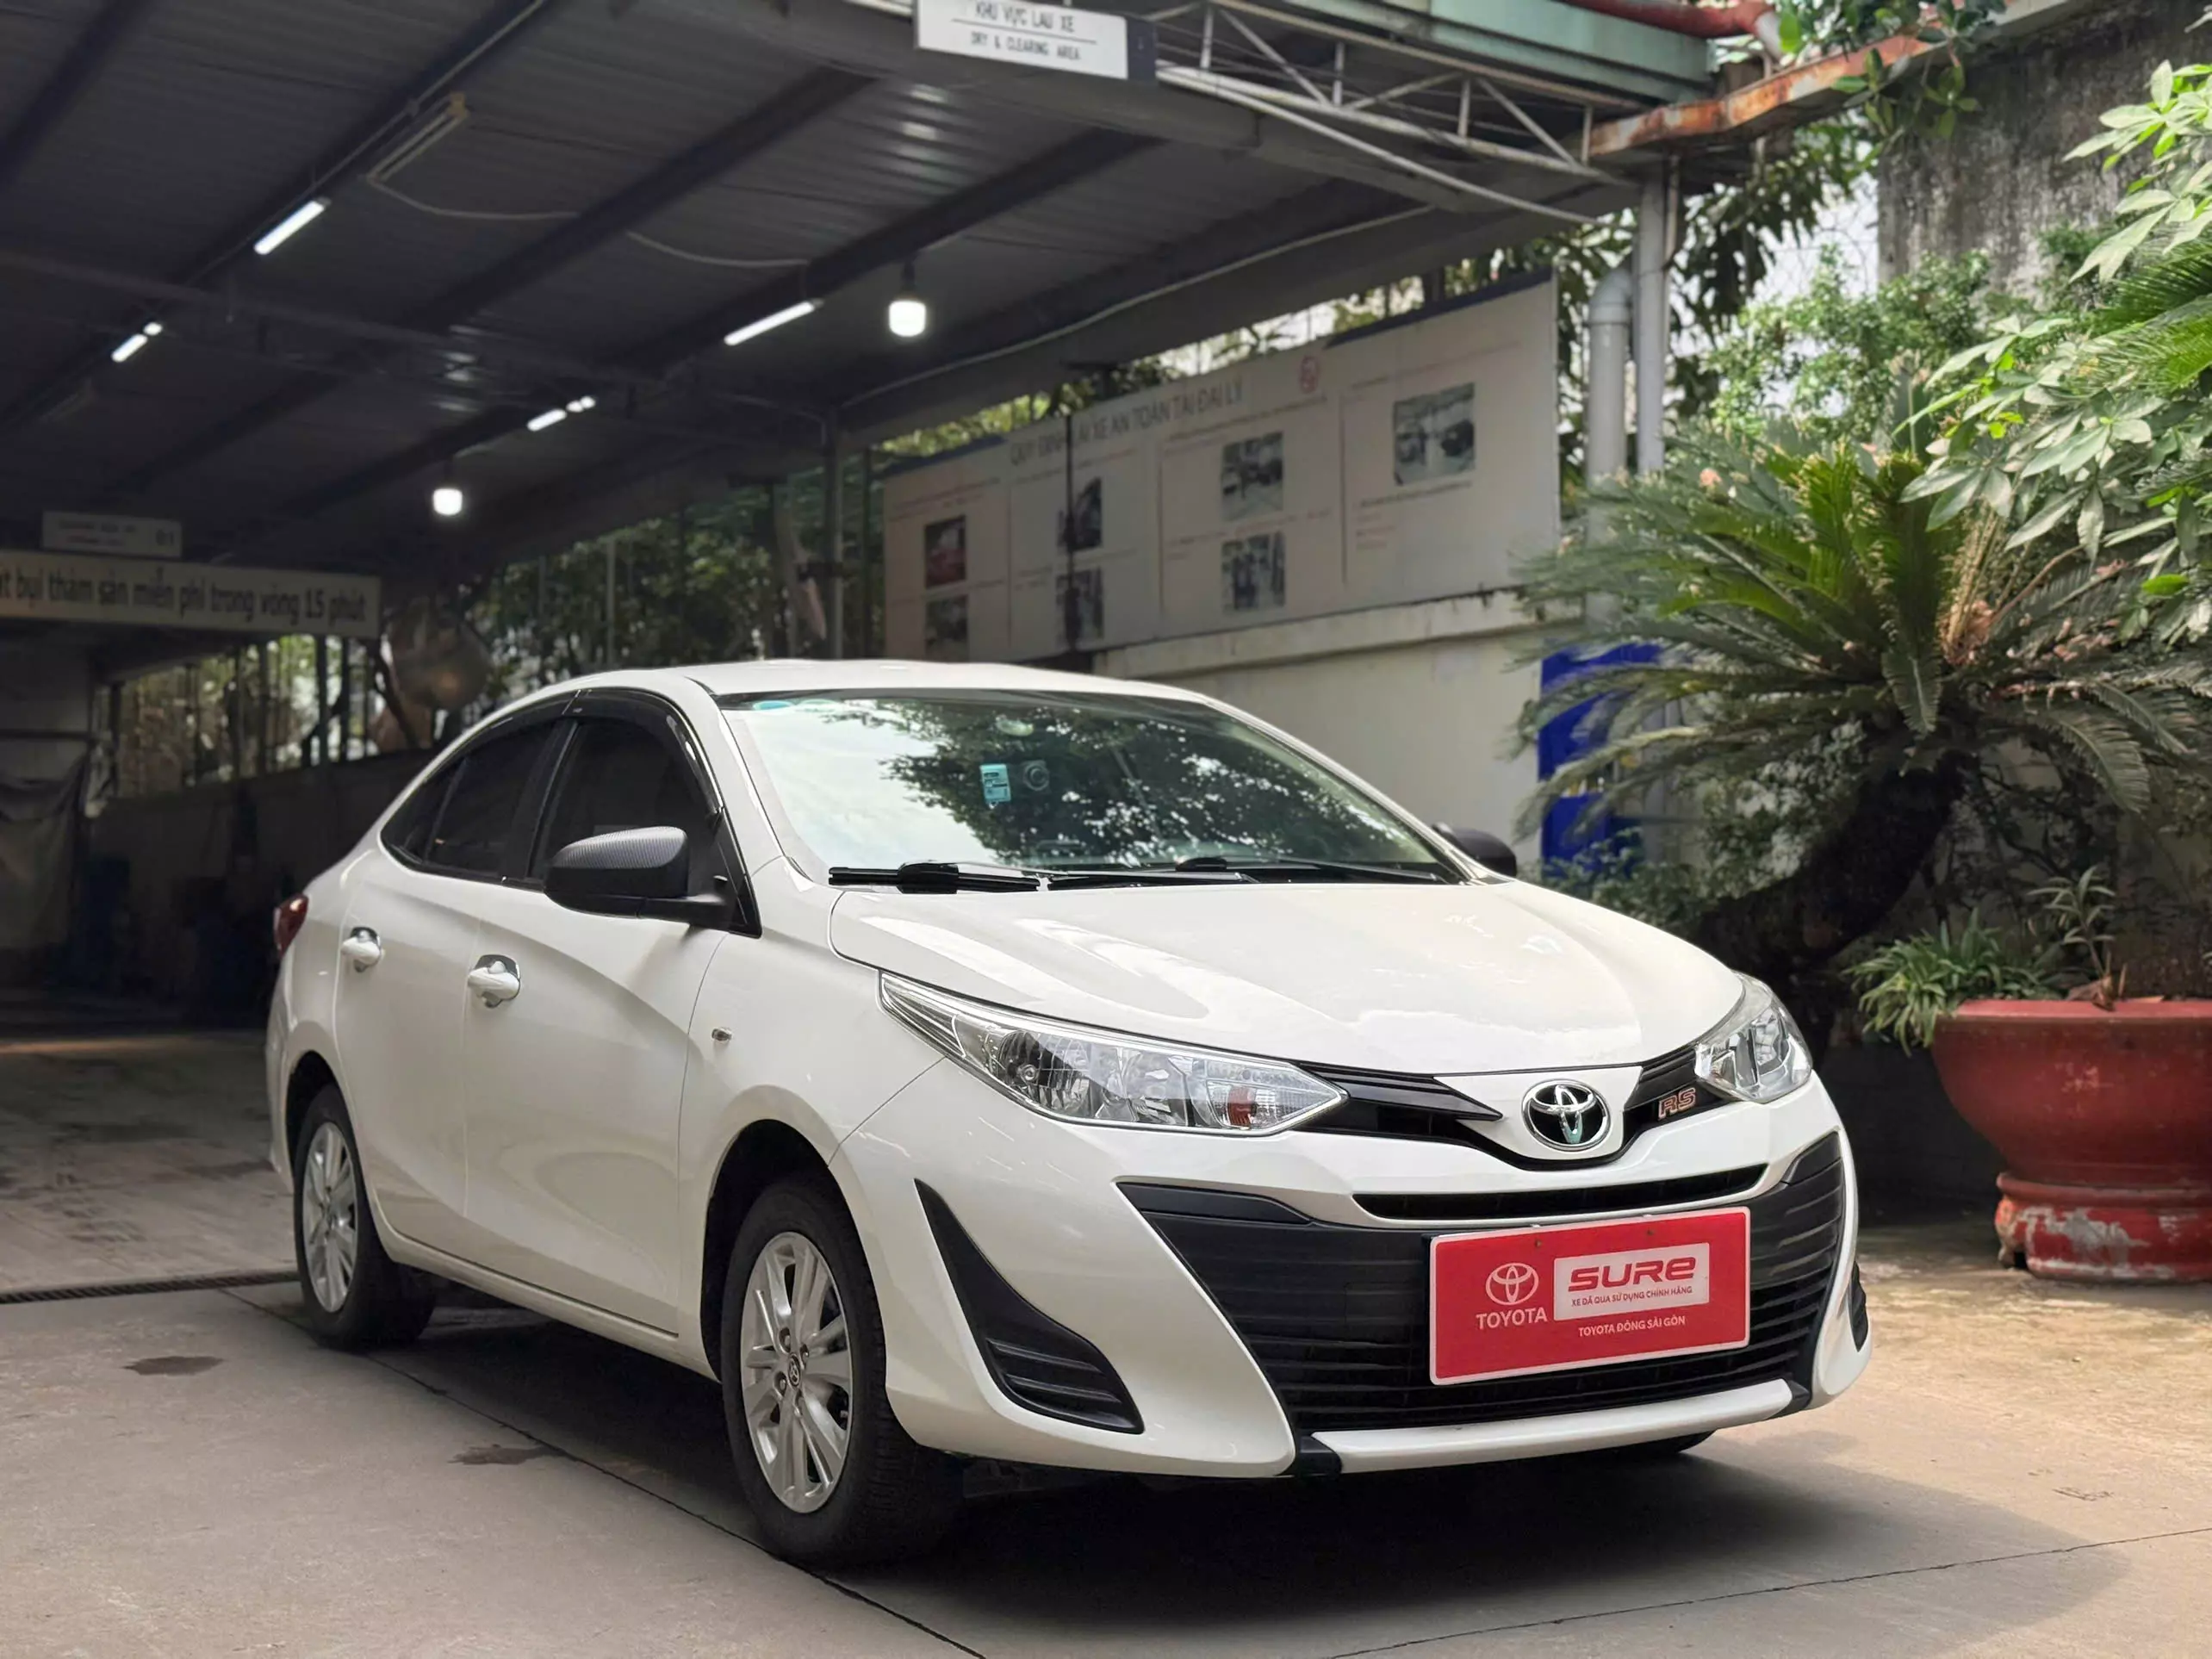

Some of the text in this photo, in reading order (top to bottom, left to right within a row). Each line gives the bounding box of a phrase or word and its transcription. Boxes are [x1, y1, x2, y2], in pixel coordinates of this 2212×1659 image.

[305, 587, 323, 618] 15
[1658, 1087, 1696, 1121] RS
[1571, 1298, 1581, 1308] XE
[1594, 1294, 1611, 1304] QUA
[1476, 1307, 1548, 1330] TOYOTA
[1578, 1324, 1615, 1337] TOYOTA
[1617, 1319, 1646, 1332] ĐÔNG
[1647, 1315, 1662, 1329] SÀI
